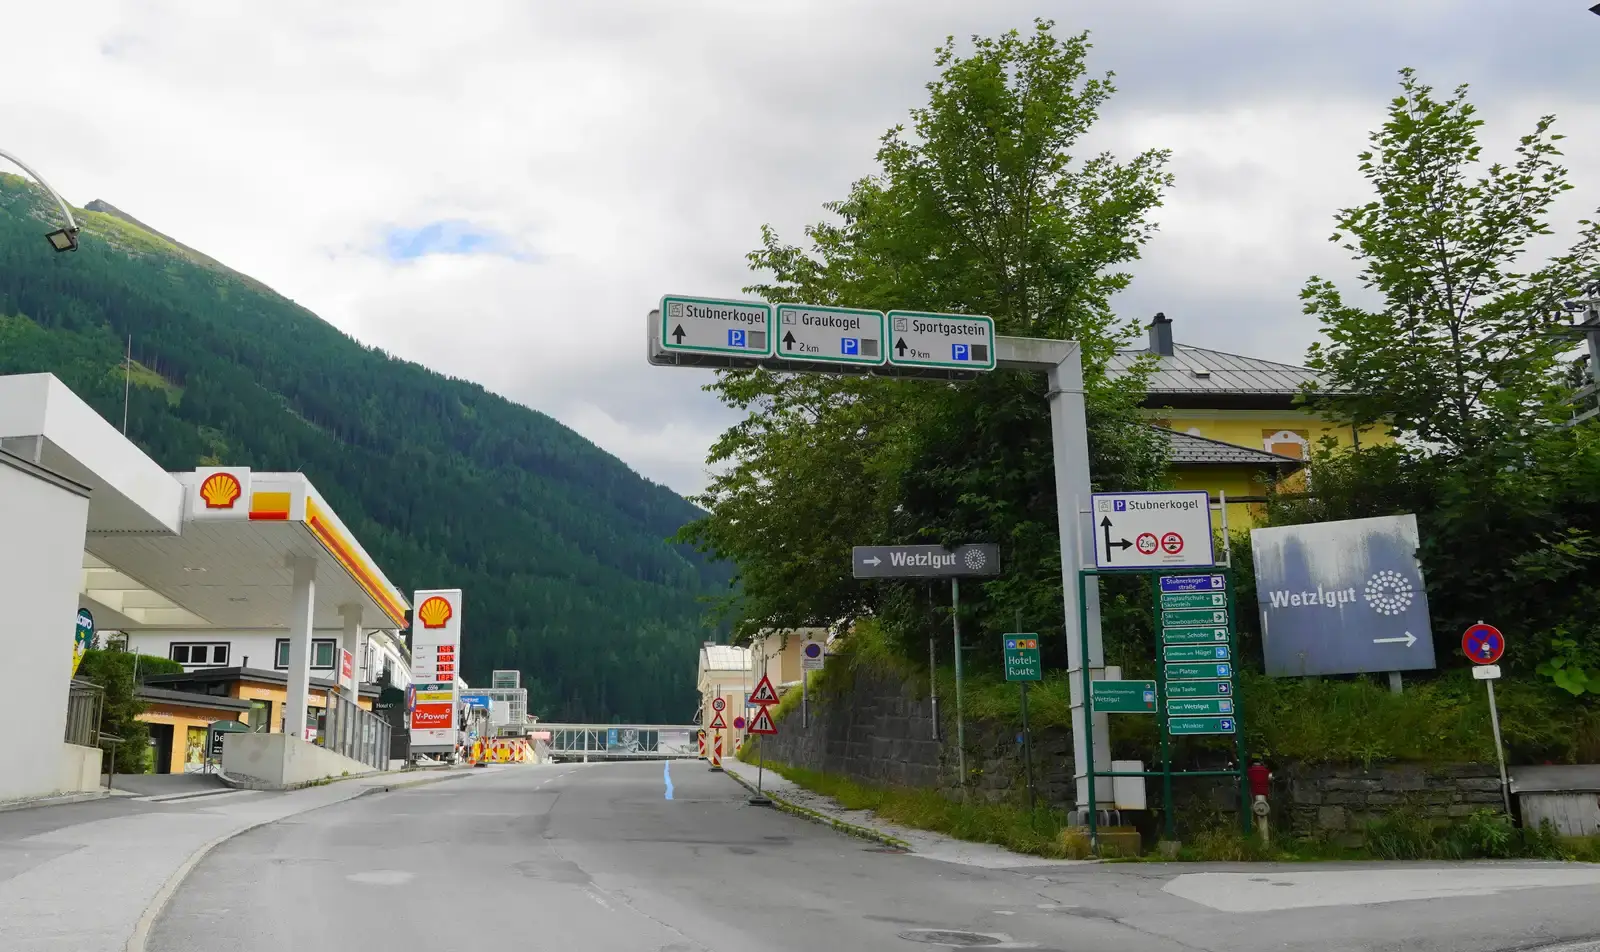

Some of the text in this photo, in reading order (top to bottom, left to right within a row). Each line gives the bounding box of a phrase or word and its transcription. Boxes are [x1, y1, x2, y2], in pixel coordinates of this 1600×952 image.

[686, 304, 765, 325] Stubnerkogel
[802, 313, 860, 330] Graukogel
[912, 320, 985, 336] Sportgastein
[800, 342, 820, 352] 2 km
[910, 348, 930, 359] 9 km
[1129, 500, 1198, 510] Stubnerkogel
[890, 552, 957, 569] Wetzlgut
[1269, 583, 1357, 608] Wetzlgut
[1008, 655, 1036, 665] Hotel-
[1009, 666, 1035, 676] Route
